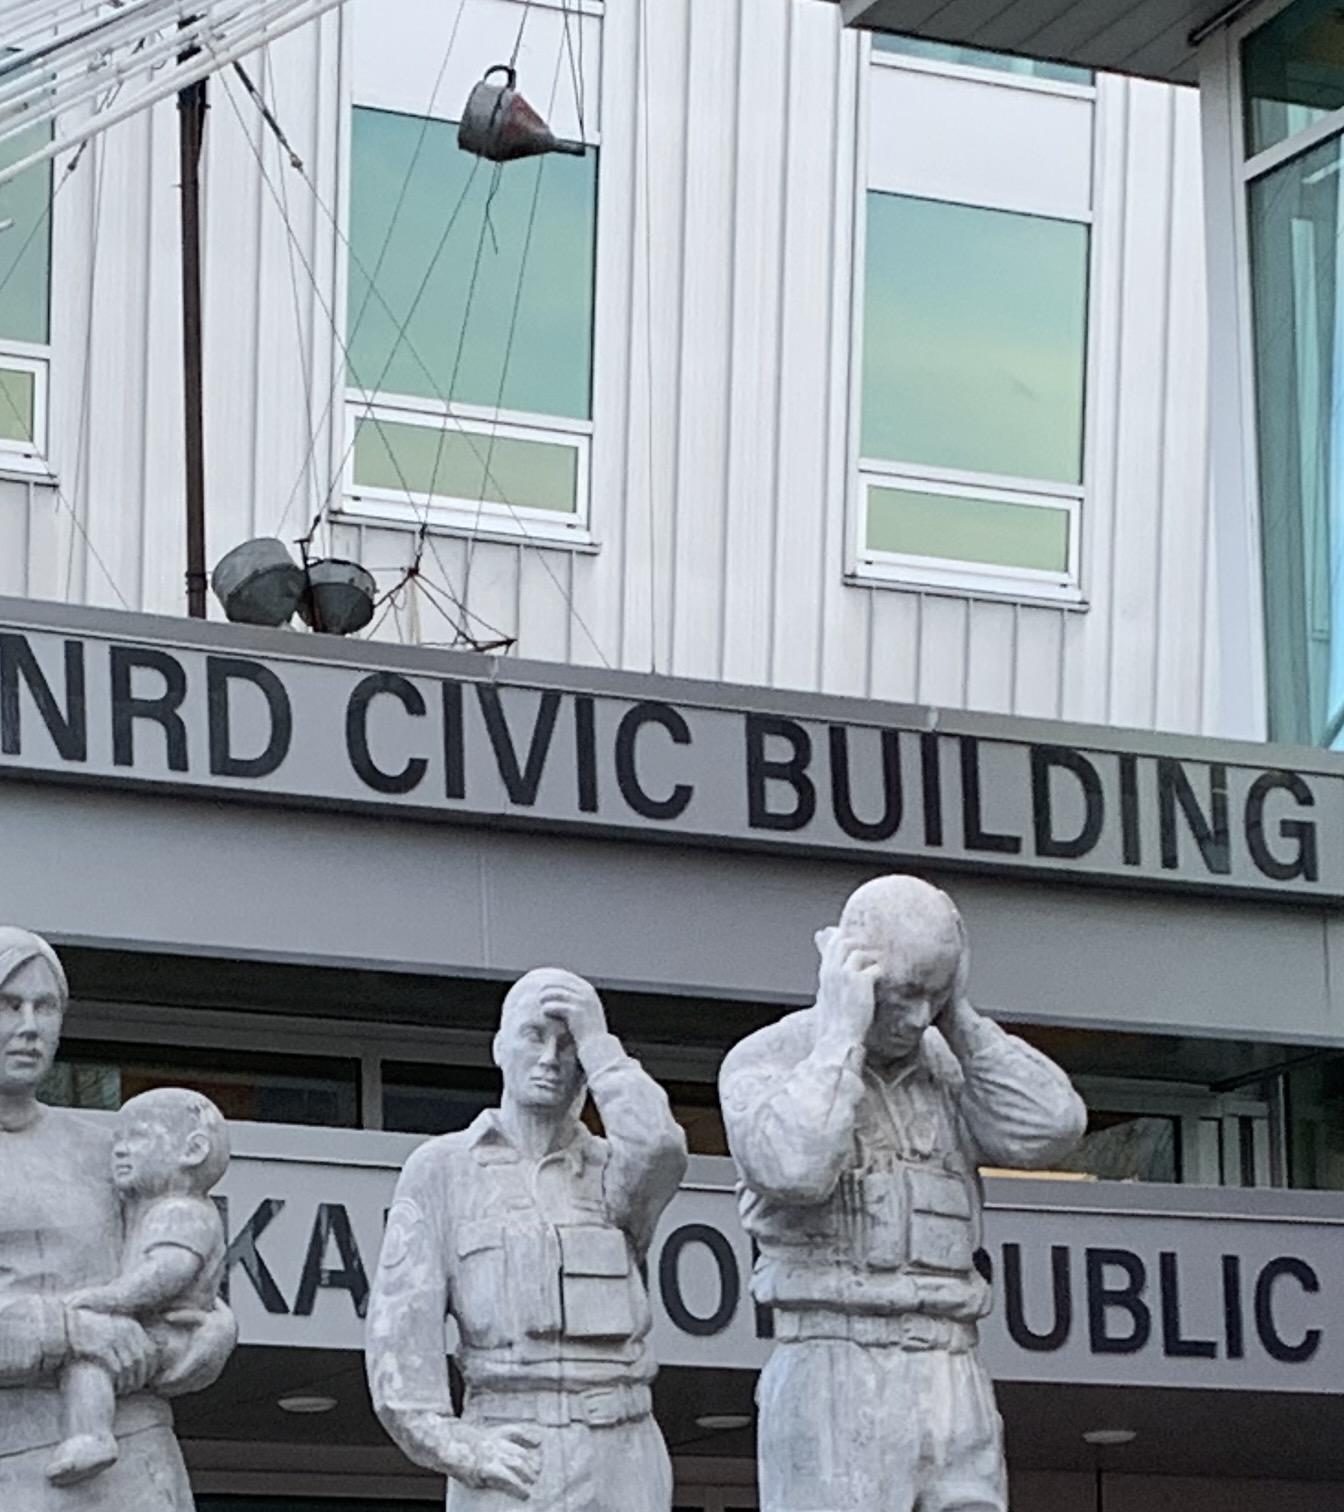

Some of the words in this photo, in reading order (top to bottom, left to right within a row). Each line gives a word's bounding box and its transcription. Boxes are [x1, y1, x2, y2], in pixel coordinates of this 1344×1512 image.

[346, 672, 693, 820] CIVIC
[747, 712, 1319, 882] BUILDING
[974, 1243, 1321, 1362] UBLIC
